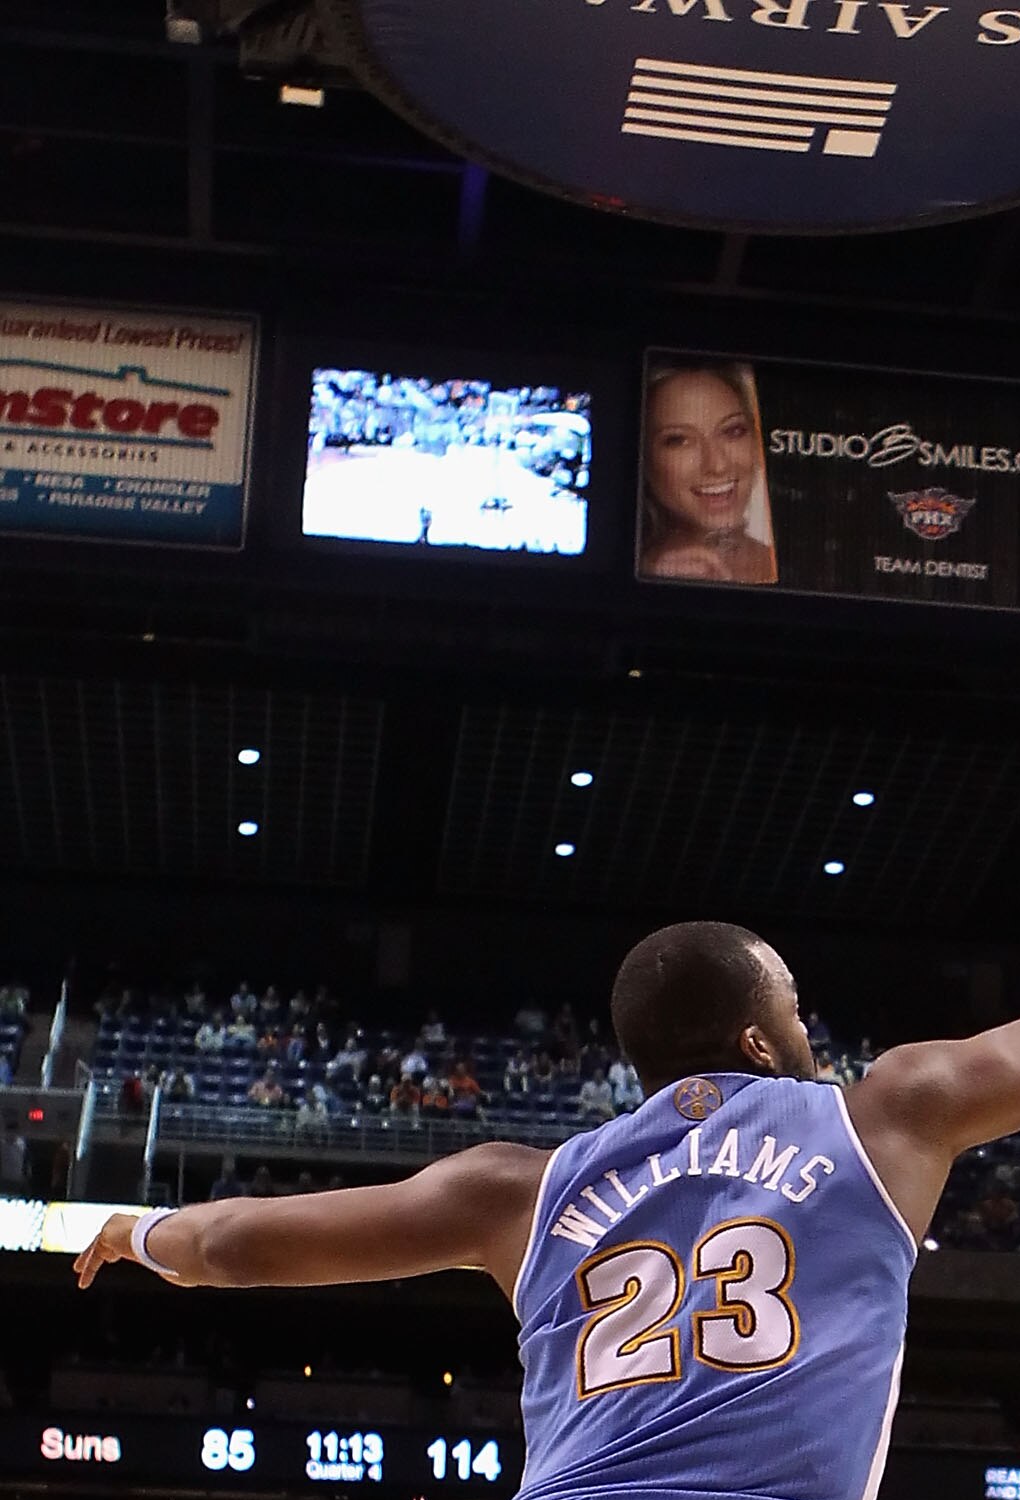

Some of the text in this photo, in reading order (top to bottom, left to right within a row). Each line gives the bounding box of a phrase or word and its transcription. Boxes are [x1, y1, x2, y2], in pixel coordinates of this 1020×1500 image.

[140, 497, 208, 515] VALLEY
[873, 556, 921, 574] TEAM
[550, 1127, 836, 1250] WILLIAMS
[574, 1214, 802, 1402] 23
[40, 1427, 502, 1482] Suns 85 11:13 114
[305, 1460, 383, 1482] Quarter 4
[985, 1485, 1017, 1500] AND
